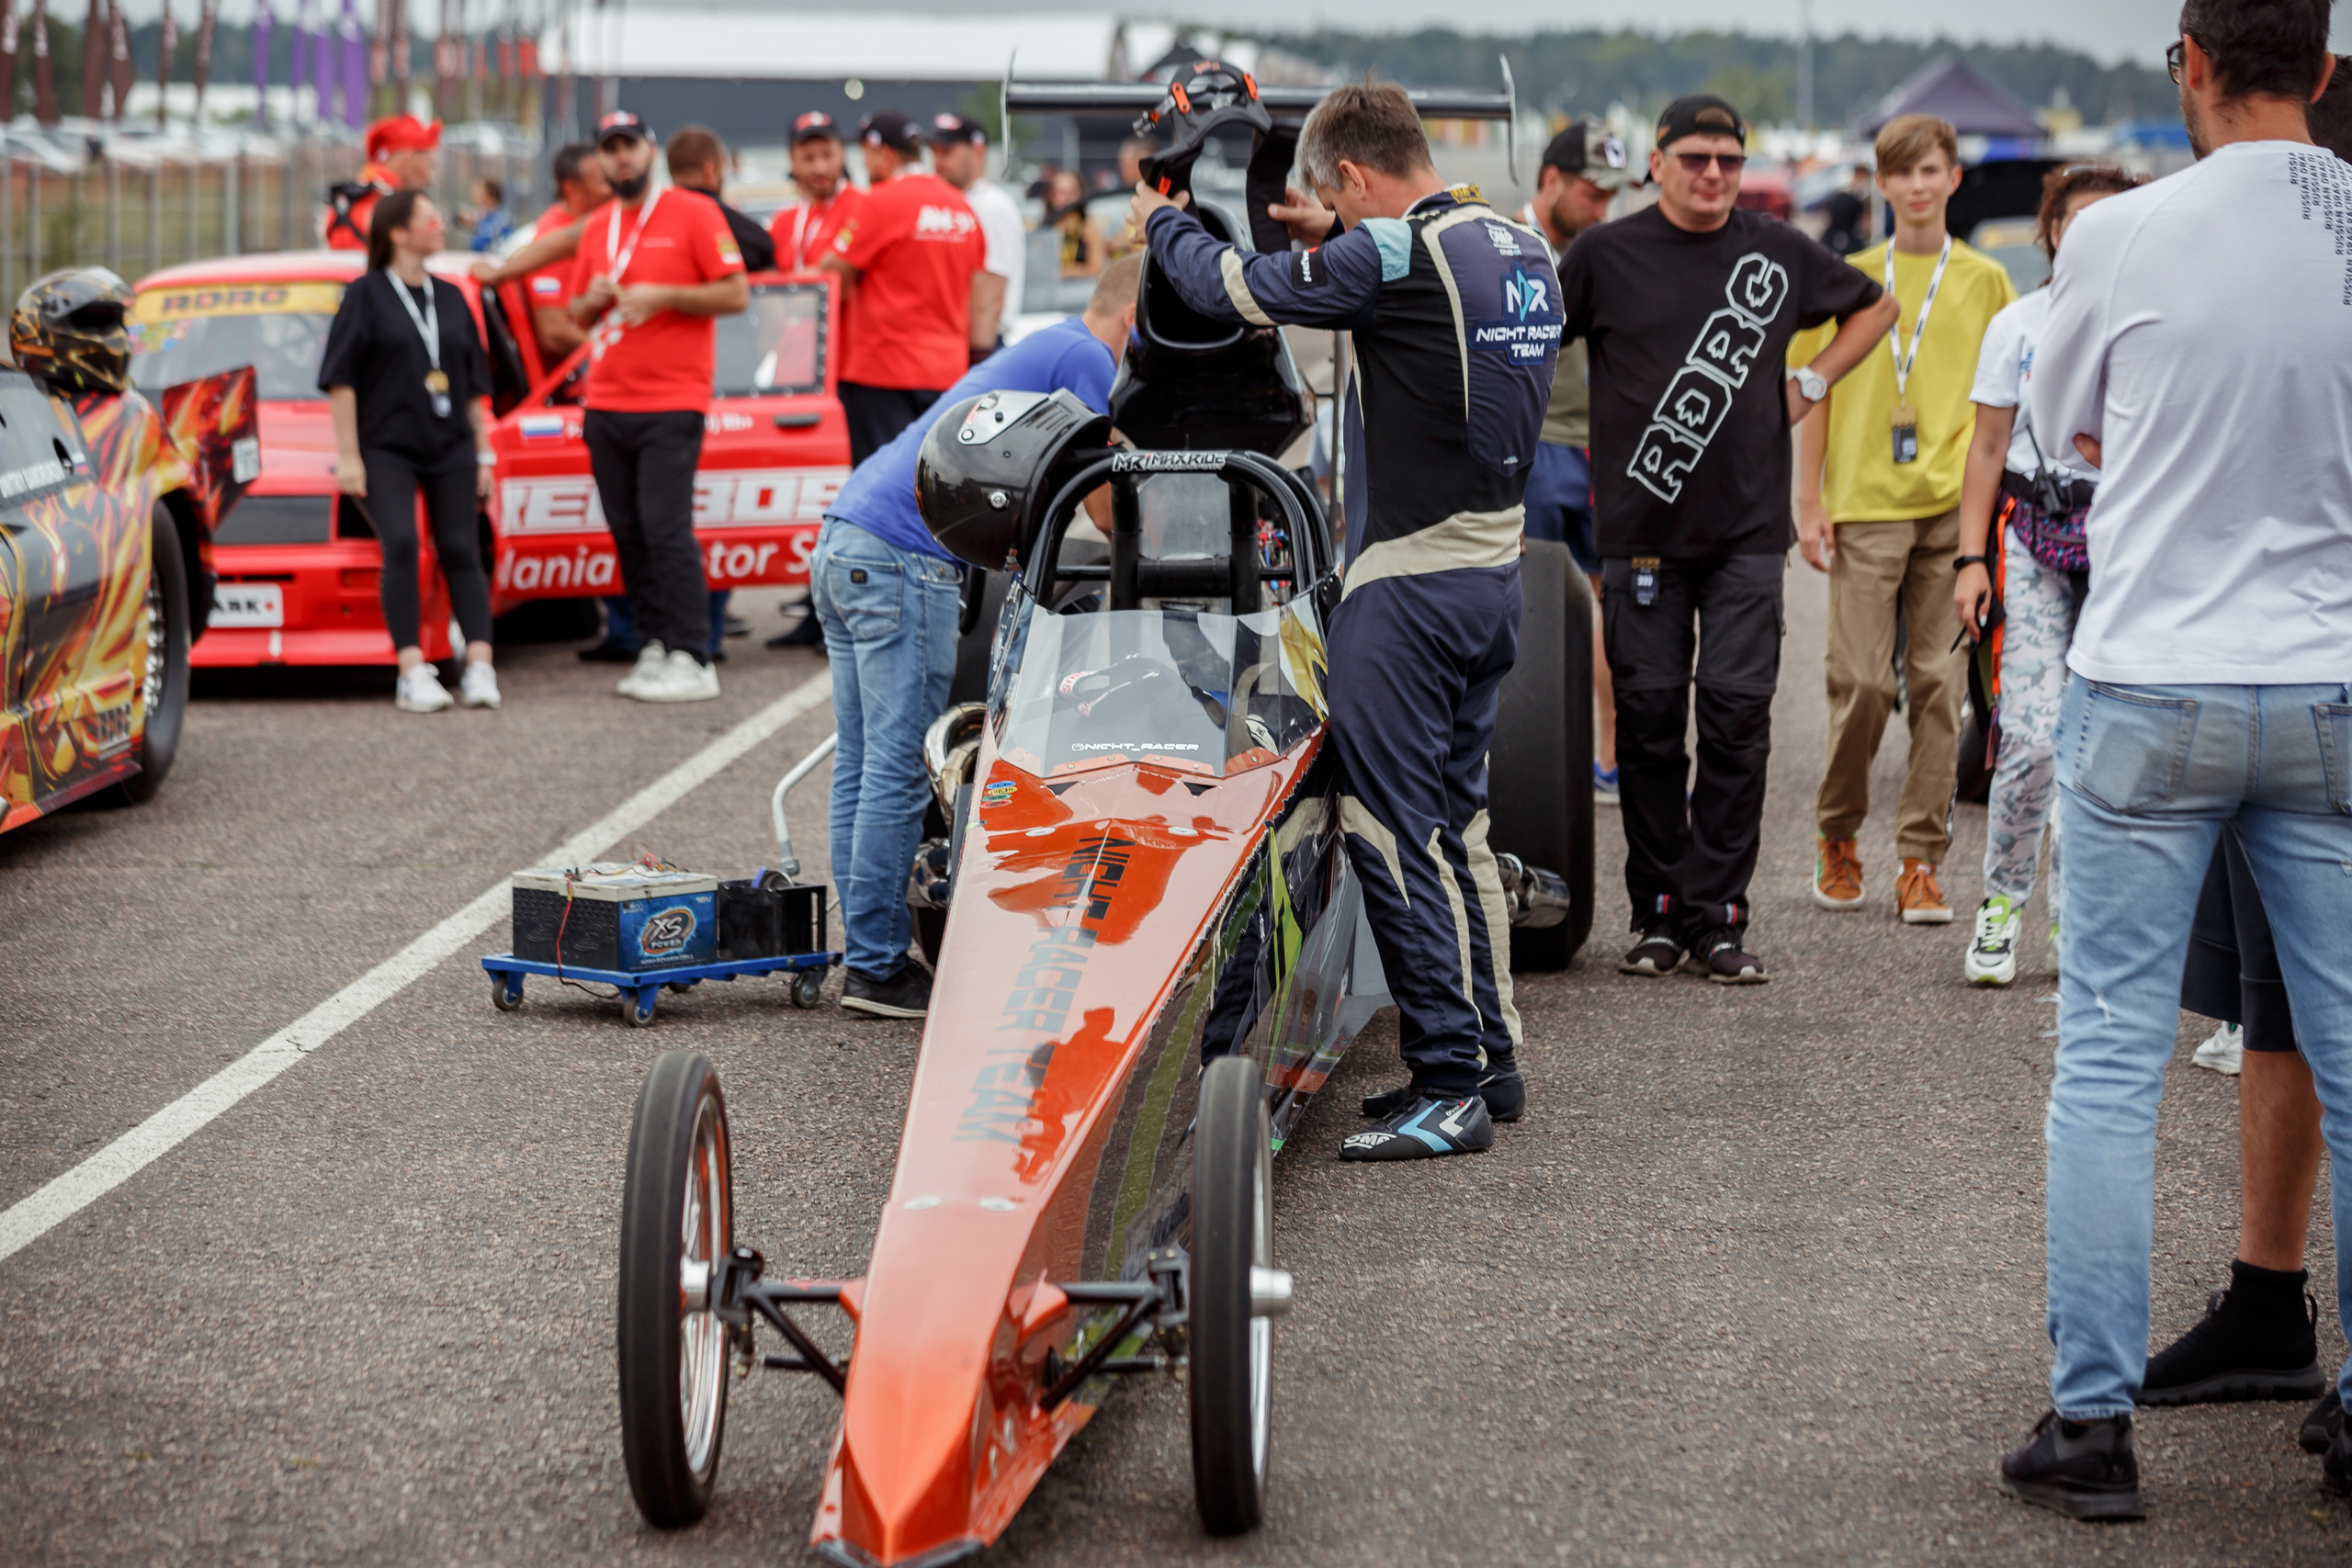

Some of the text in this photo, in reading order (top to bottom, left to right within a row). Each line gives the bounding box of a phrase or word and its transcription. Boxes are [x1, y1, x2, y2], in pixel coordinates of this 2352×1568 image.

[1476, 326, 1526, 342] NIGHT
[1511, 342, 1545, 358] TEAM
[649, 916, 683, 942] XS
[651, 939, 682, 949] POWER
[995, 926, 1099, 1033] RACER
